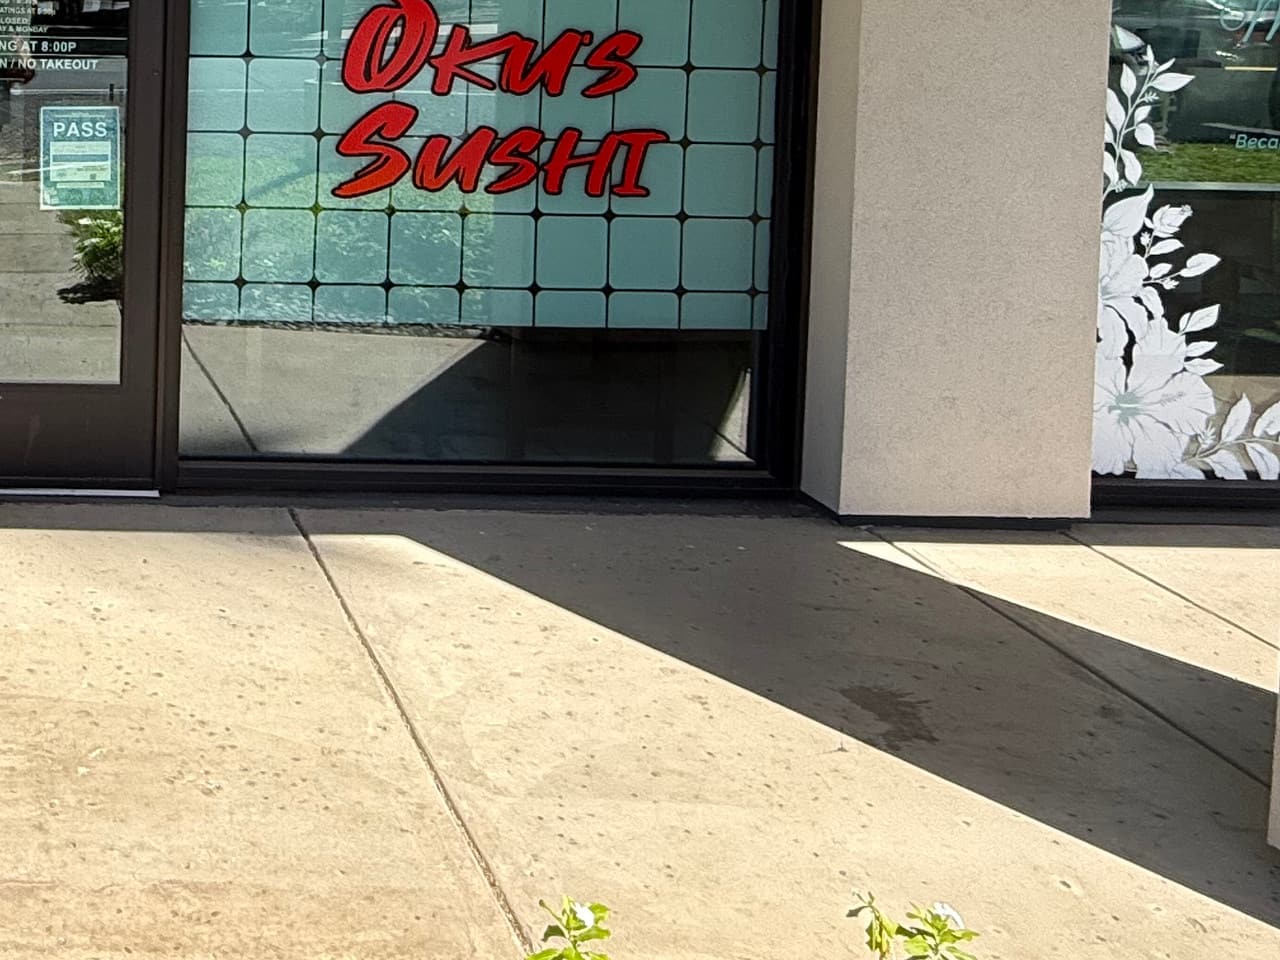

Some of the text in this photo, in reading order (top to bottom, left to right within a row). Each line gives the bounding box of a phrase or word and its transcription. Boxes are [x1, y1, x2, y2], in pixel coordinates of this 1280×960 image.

[21, 40, 38, 52] AT
[41, 41, 77, 53] 8:00P
[18, 58, 37, 70] NO
[39, 59, 99, 70] TAKEOUT
[53, 121, 108, 138] PASS
[1229, 133, 1280, 149] "Beca
